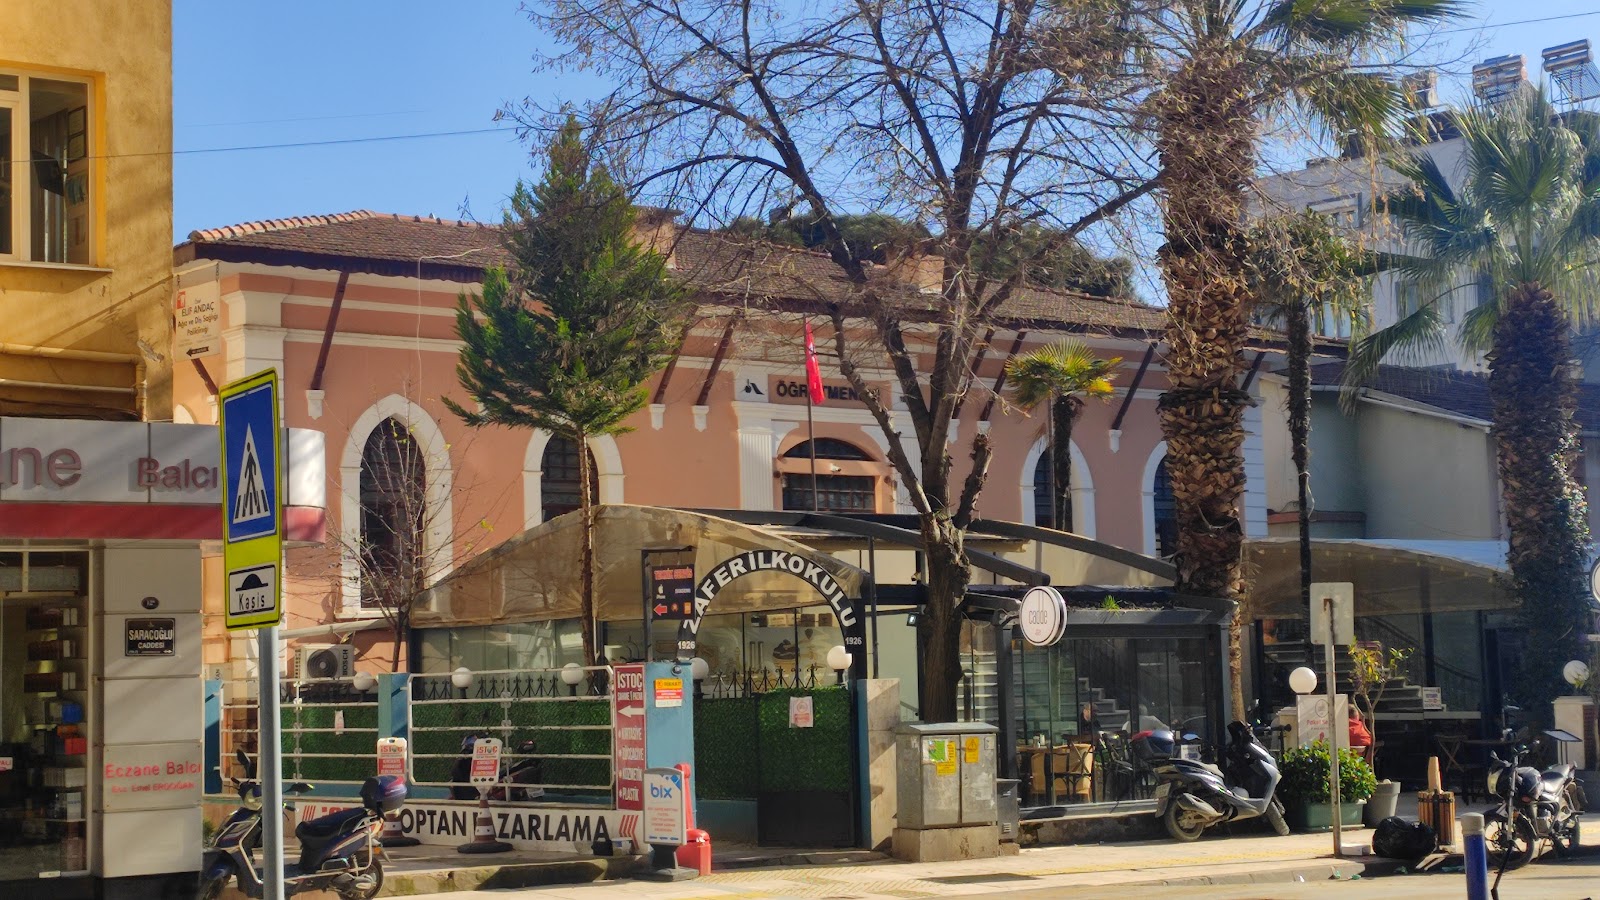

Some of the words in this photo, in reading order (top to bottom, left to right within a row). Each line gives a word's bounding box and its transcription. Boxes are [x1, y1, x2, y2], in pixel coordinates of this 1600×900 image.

[193, 302, 215, 313] ANDAÇ
[0, 447, 82, 487] ne
[137, 457, 218, 489] Balcı
[238, 594, 265, 611] Kasis
[677, 641, 696, 650] 1926
[845, 637, 863, 645] 1926
[617, 671, 643, 692] İSTOÇ
[105, 762, 161, 780] Eczane
